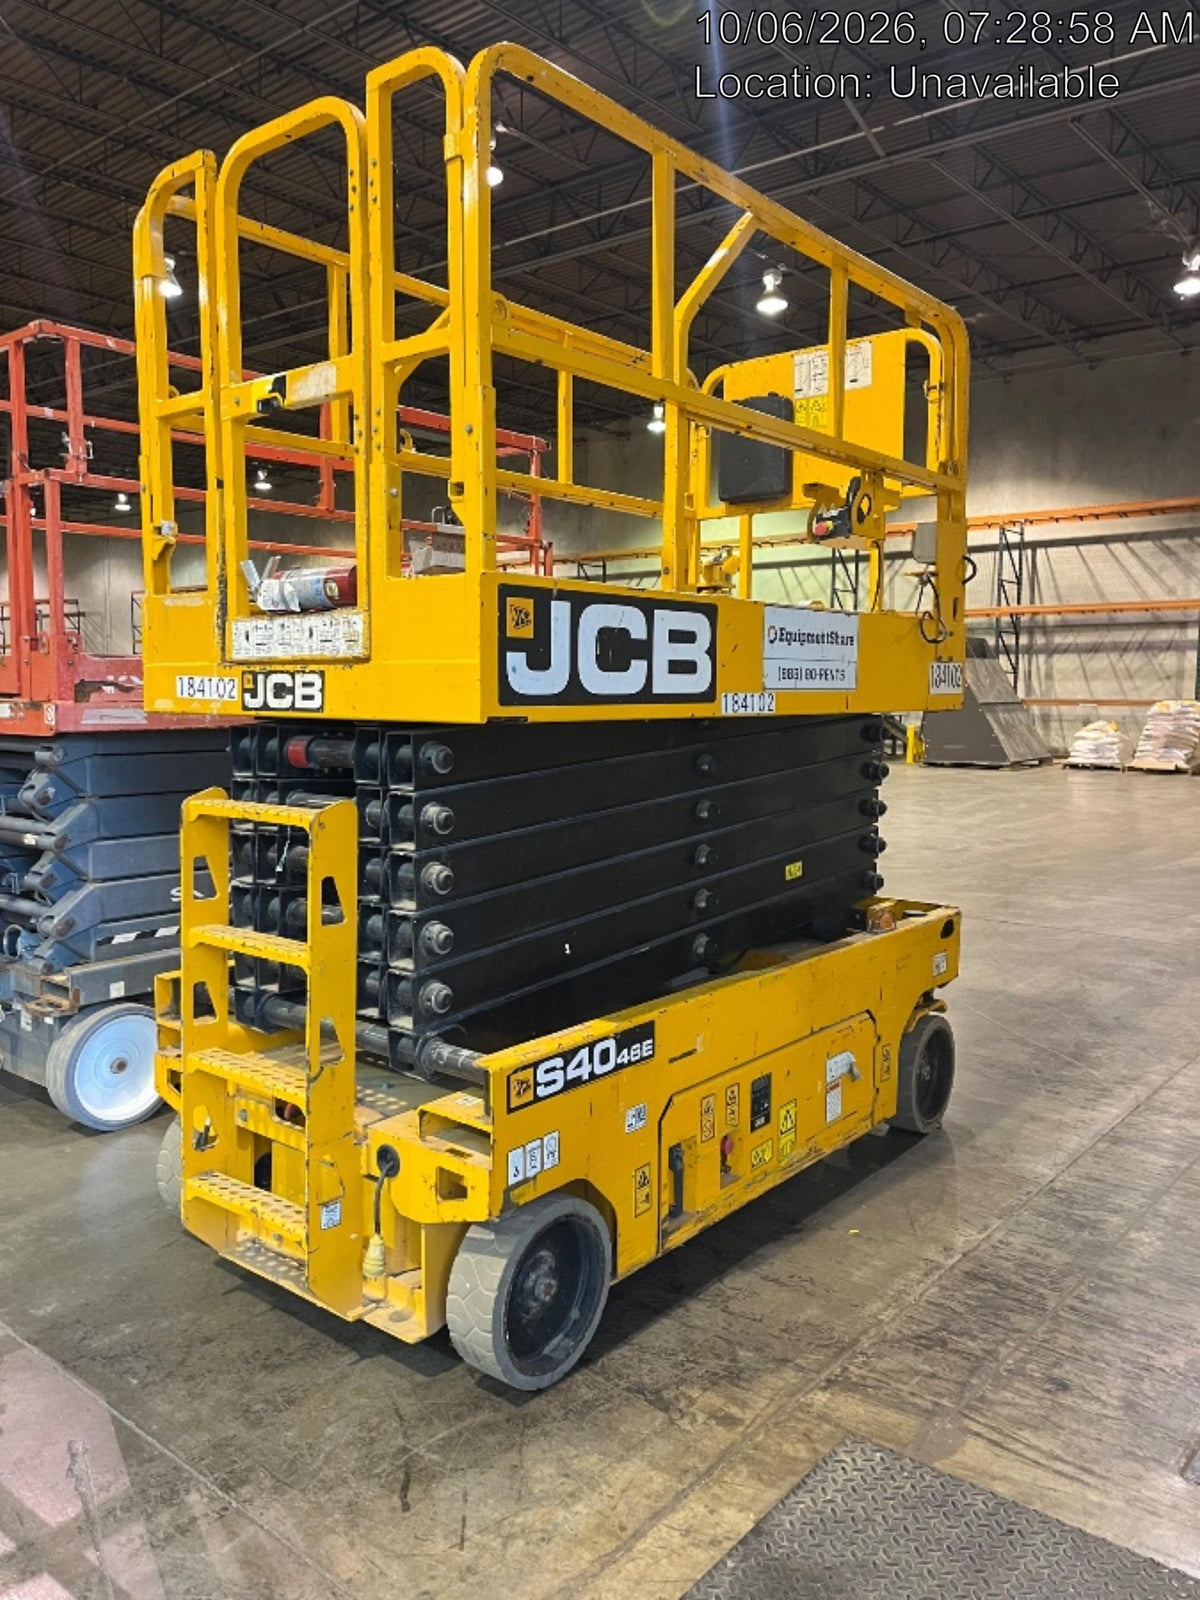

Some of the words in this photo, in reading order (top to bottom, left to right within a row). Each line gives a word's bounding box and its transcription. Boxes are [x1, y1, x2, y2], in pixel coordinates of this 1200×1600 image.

[506, 600, 712, 696] JCB
[178, 676, 236, 700] 184102
[931, 664, 963, 689] 184102
[243, 672, 323, 709] JCB
[723, 692, 774, 714] 184102
